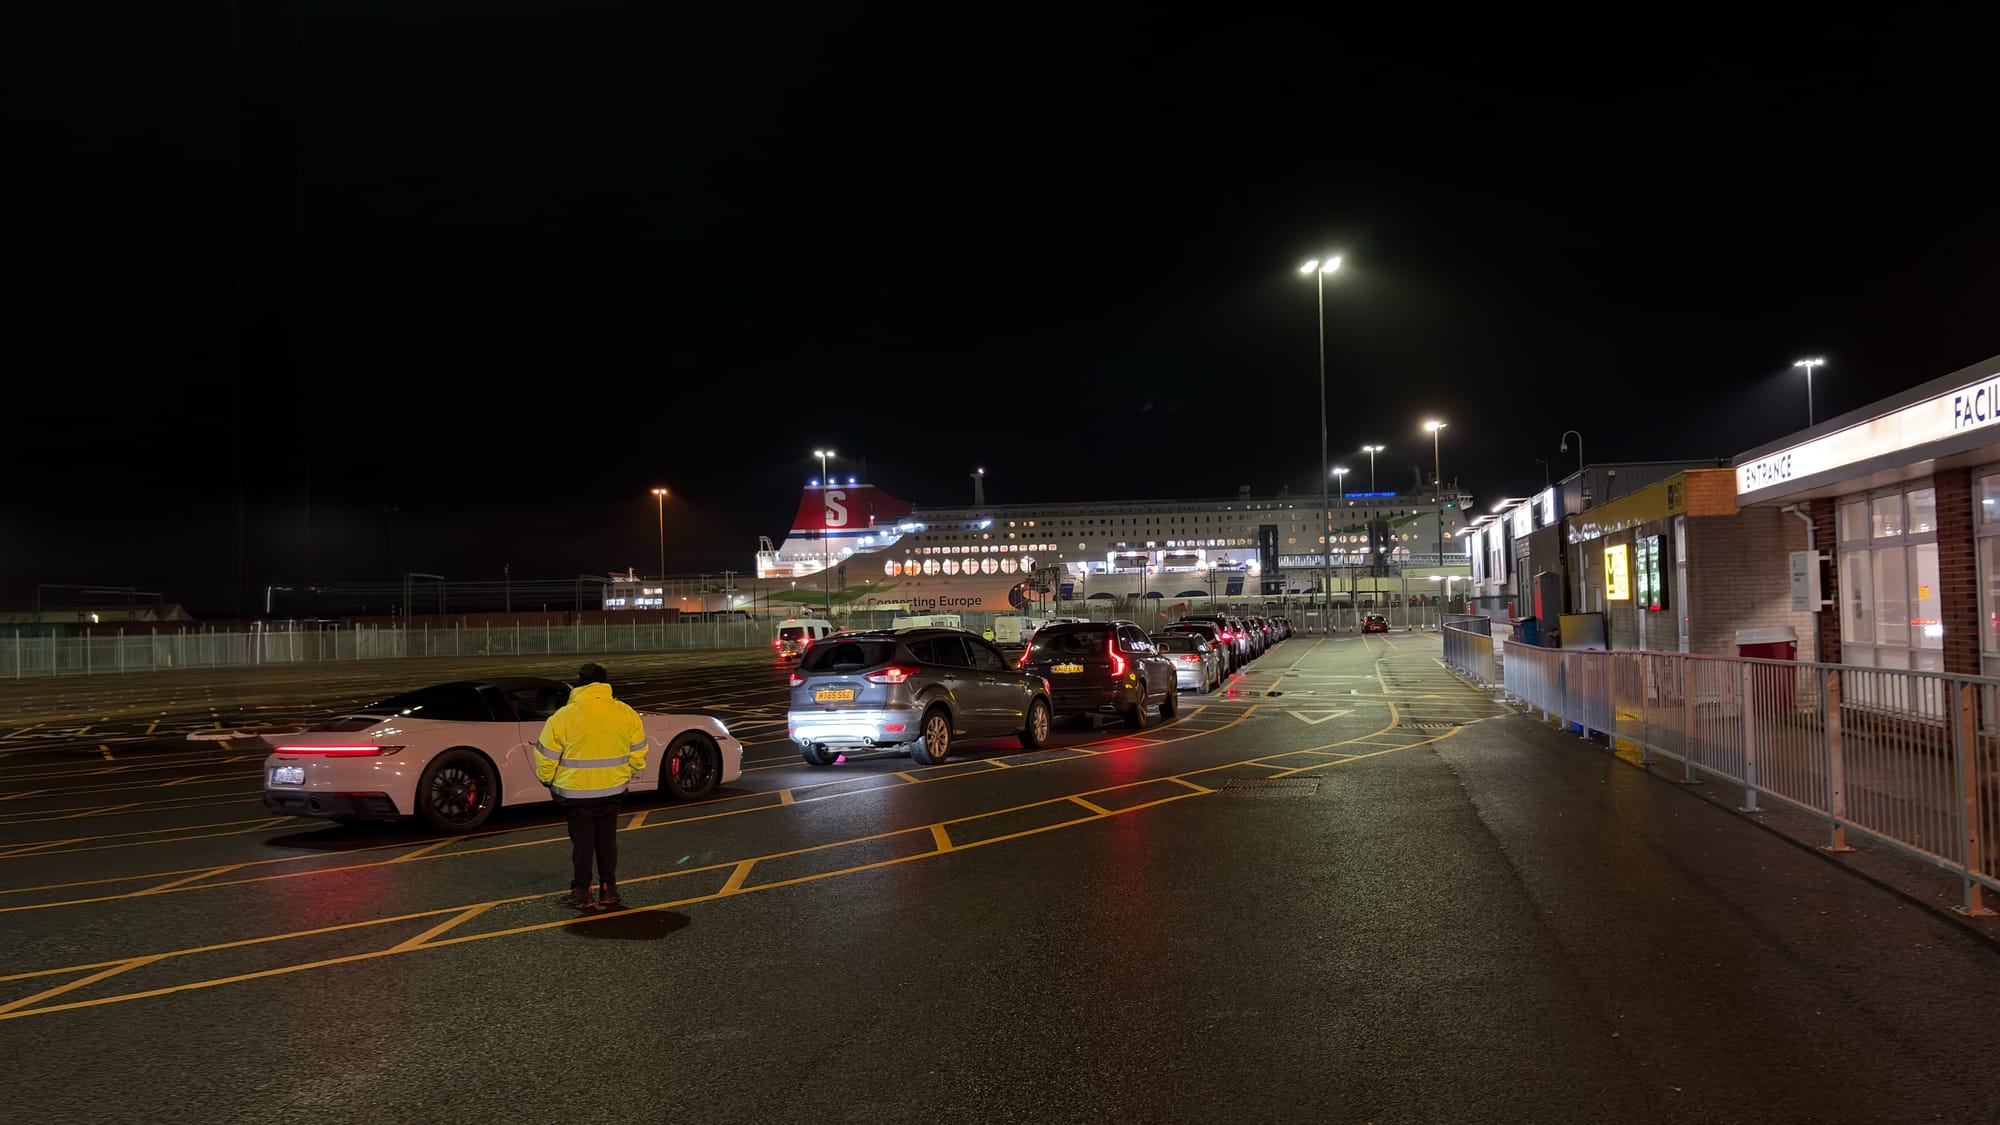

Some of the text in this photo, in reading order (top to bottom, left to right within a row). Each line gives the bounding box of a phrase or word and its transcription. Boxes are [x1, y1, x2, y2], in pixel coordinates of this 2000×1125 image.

[1746, 454, 1791, 489] ENTRANCE
[825, 490, 848, 527] S
[939, 595, 982, 607] Europe
